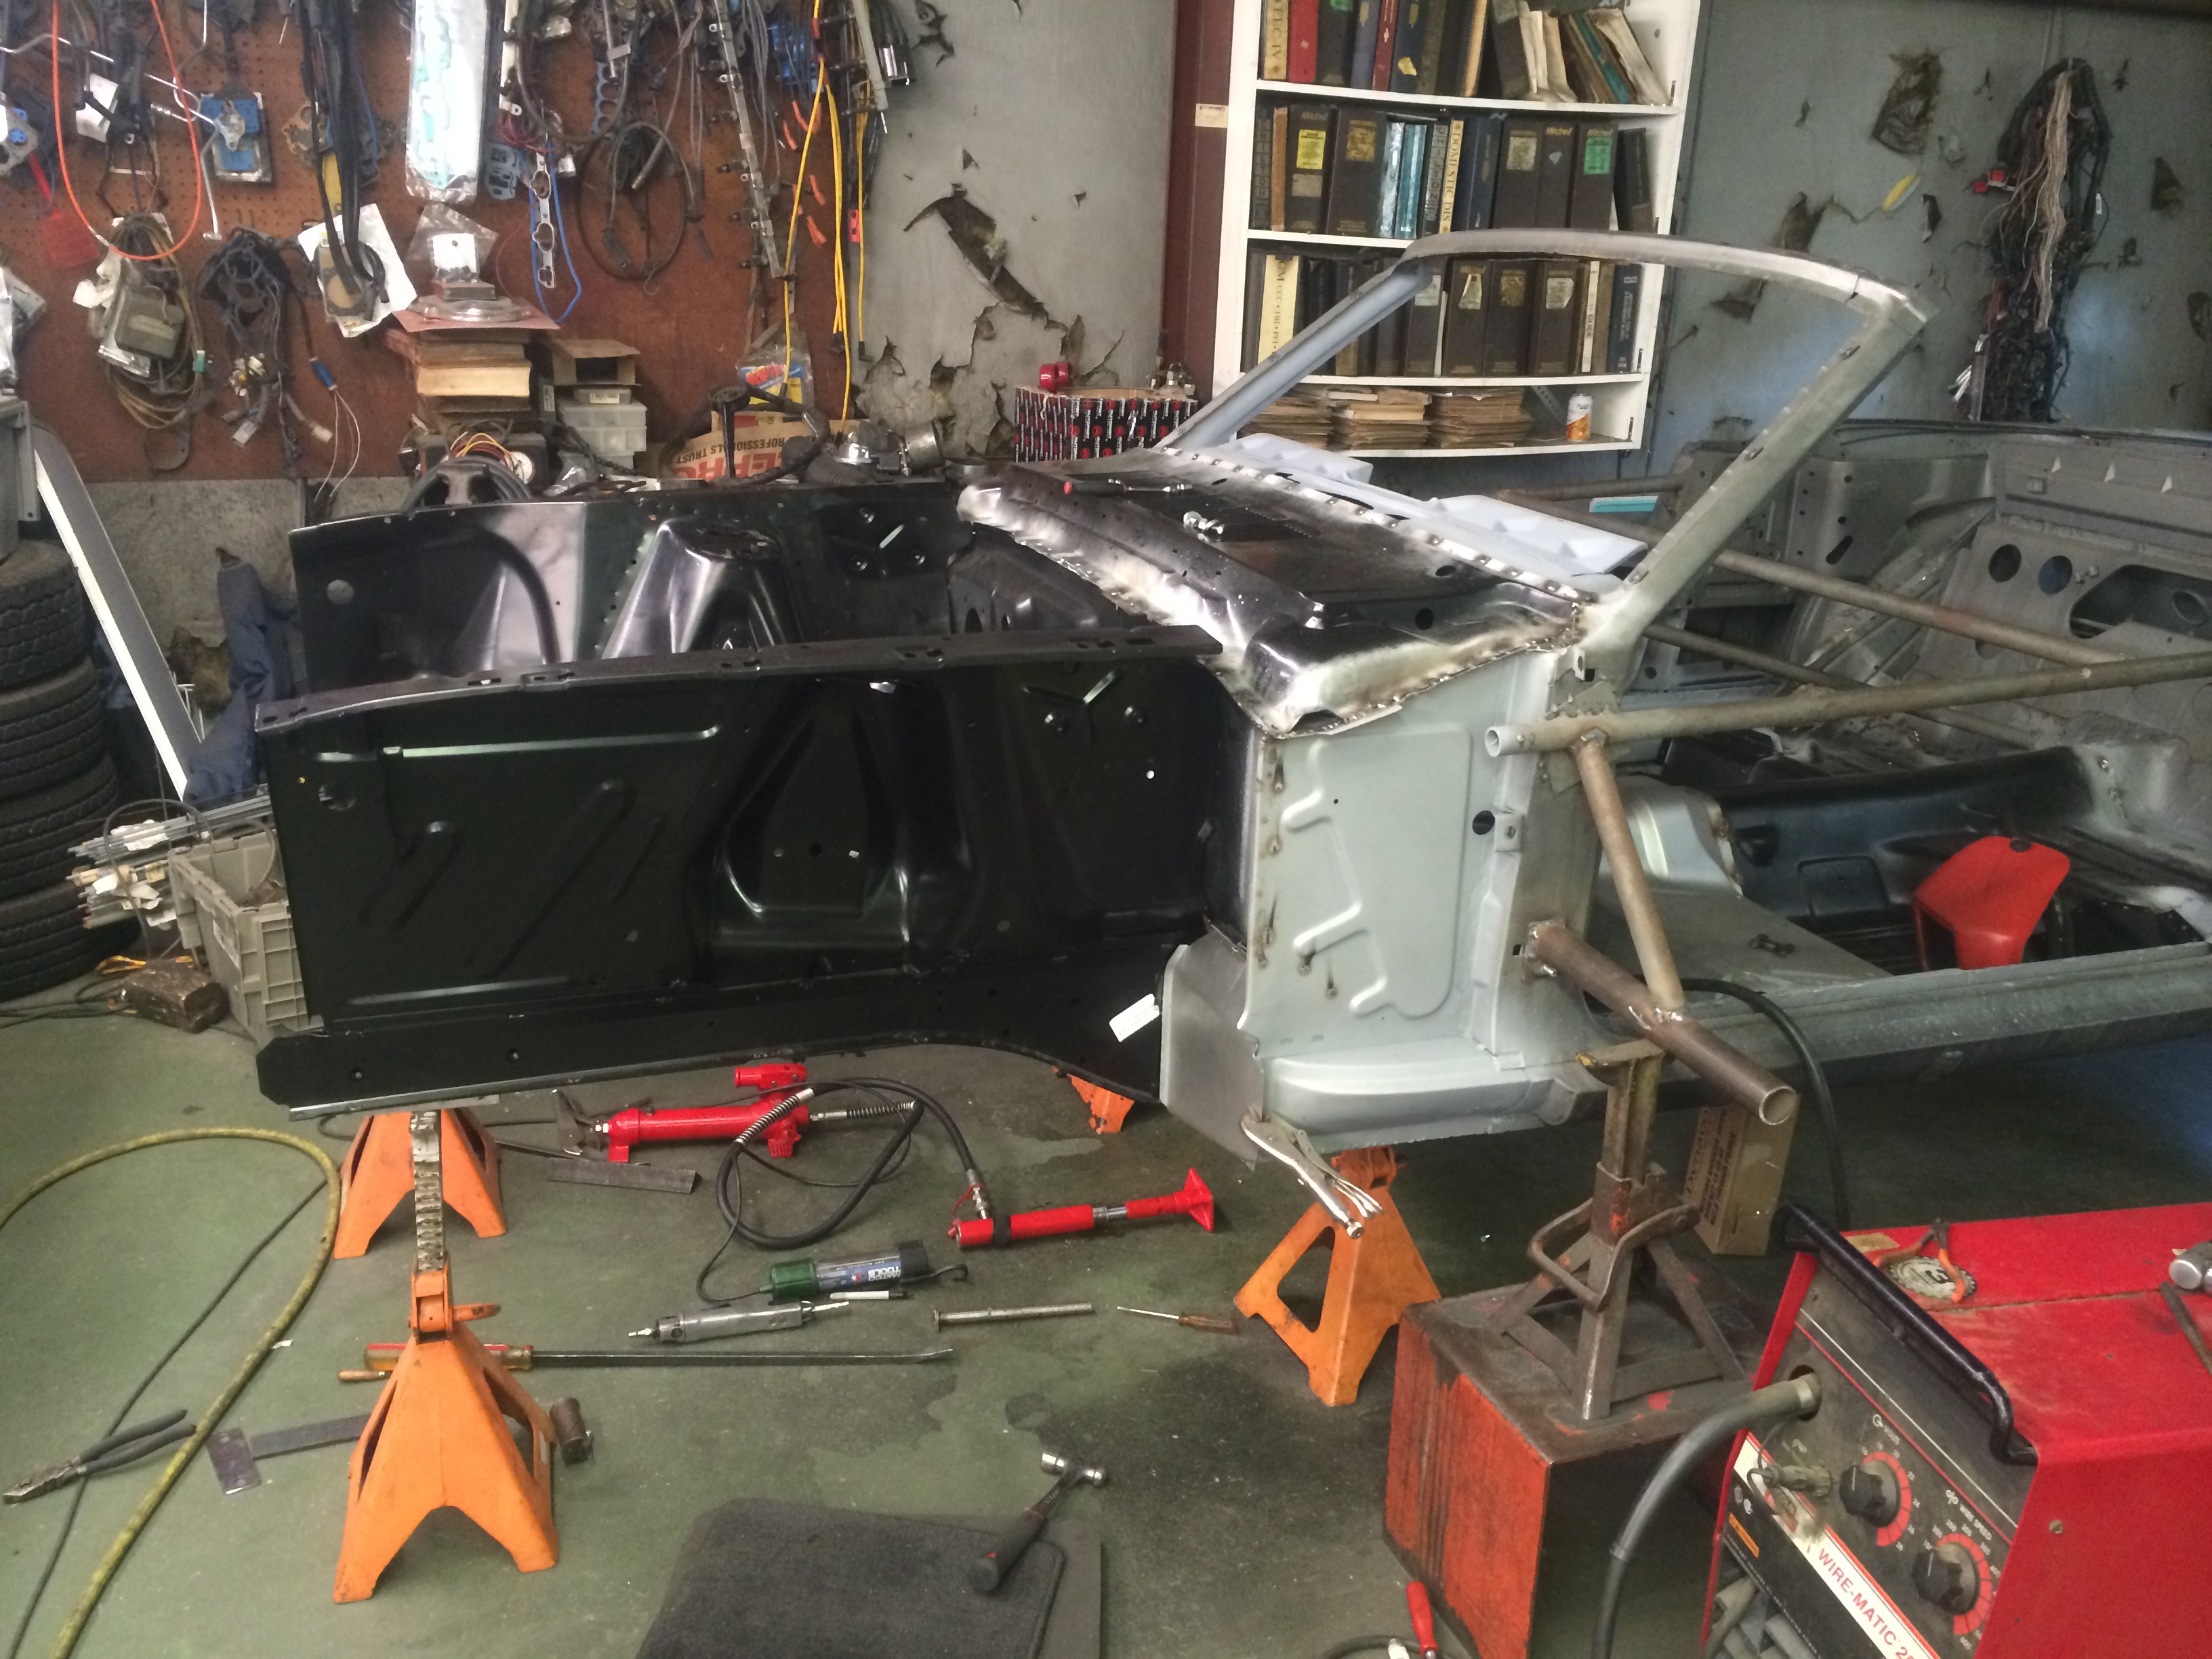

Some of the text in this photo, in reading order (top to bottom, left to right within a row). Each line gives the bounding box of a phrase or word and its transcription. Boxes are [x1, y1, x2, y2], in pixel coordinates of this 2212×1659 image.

[1429, 127, 1446, 201] CHILTON
[1441, 132, 1462, 222] DOMESTIC DIS
[1276, 261, 1287, 282] GM
[676, 448, 707, 464] TRUST
[868, 1266, 900, 1276] TOOLS
[868, 1271, 901, 1282] MATCO
[1960, 1504, 1992, 1540] WIRE SPEED
[1818, 1548, 1897, 1645] WIRE-MATIC
